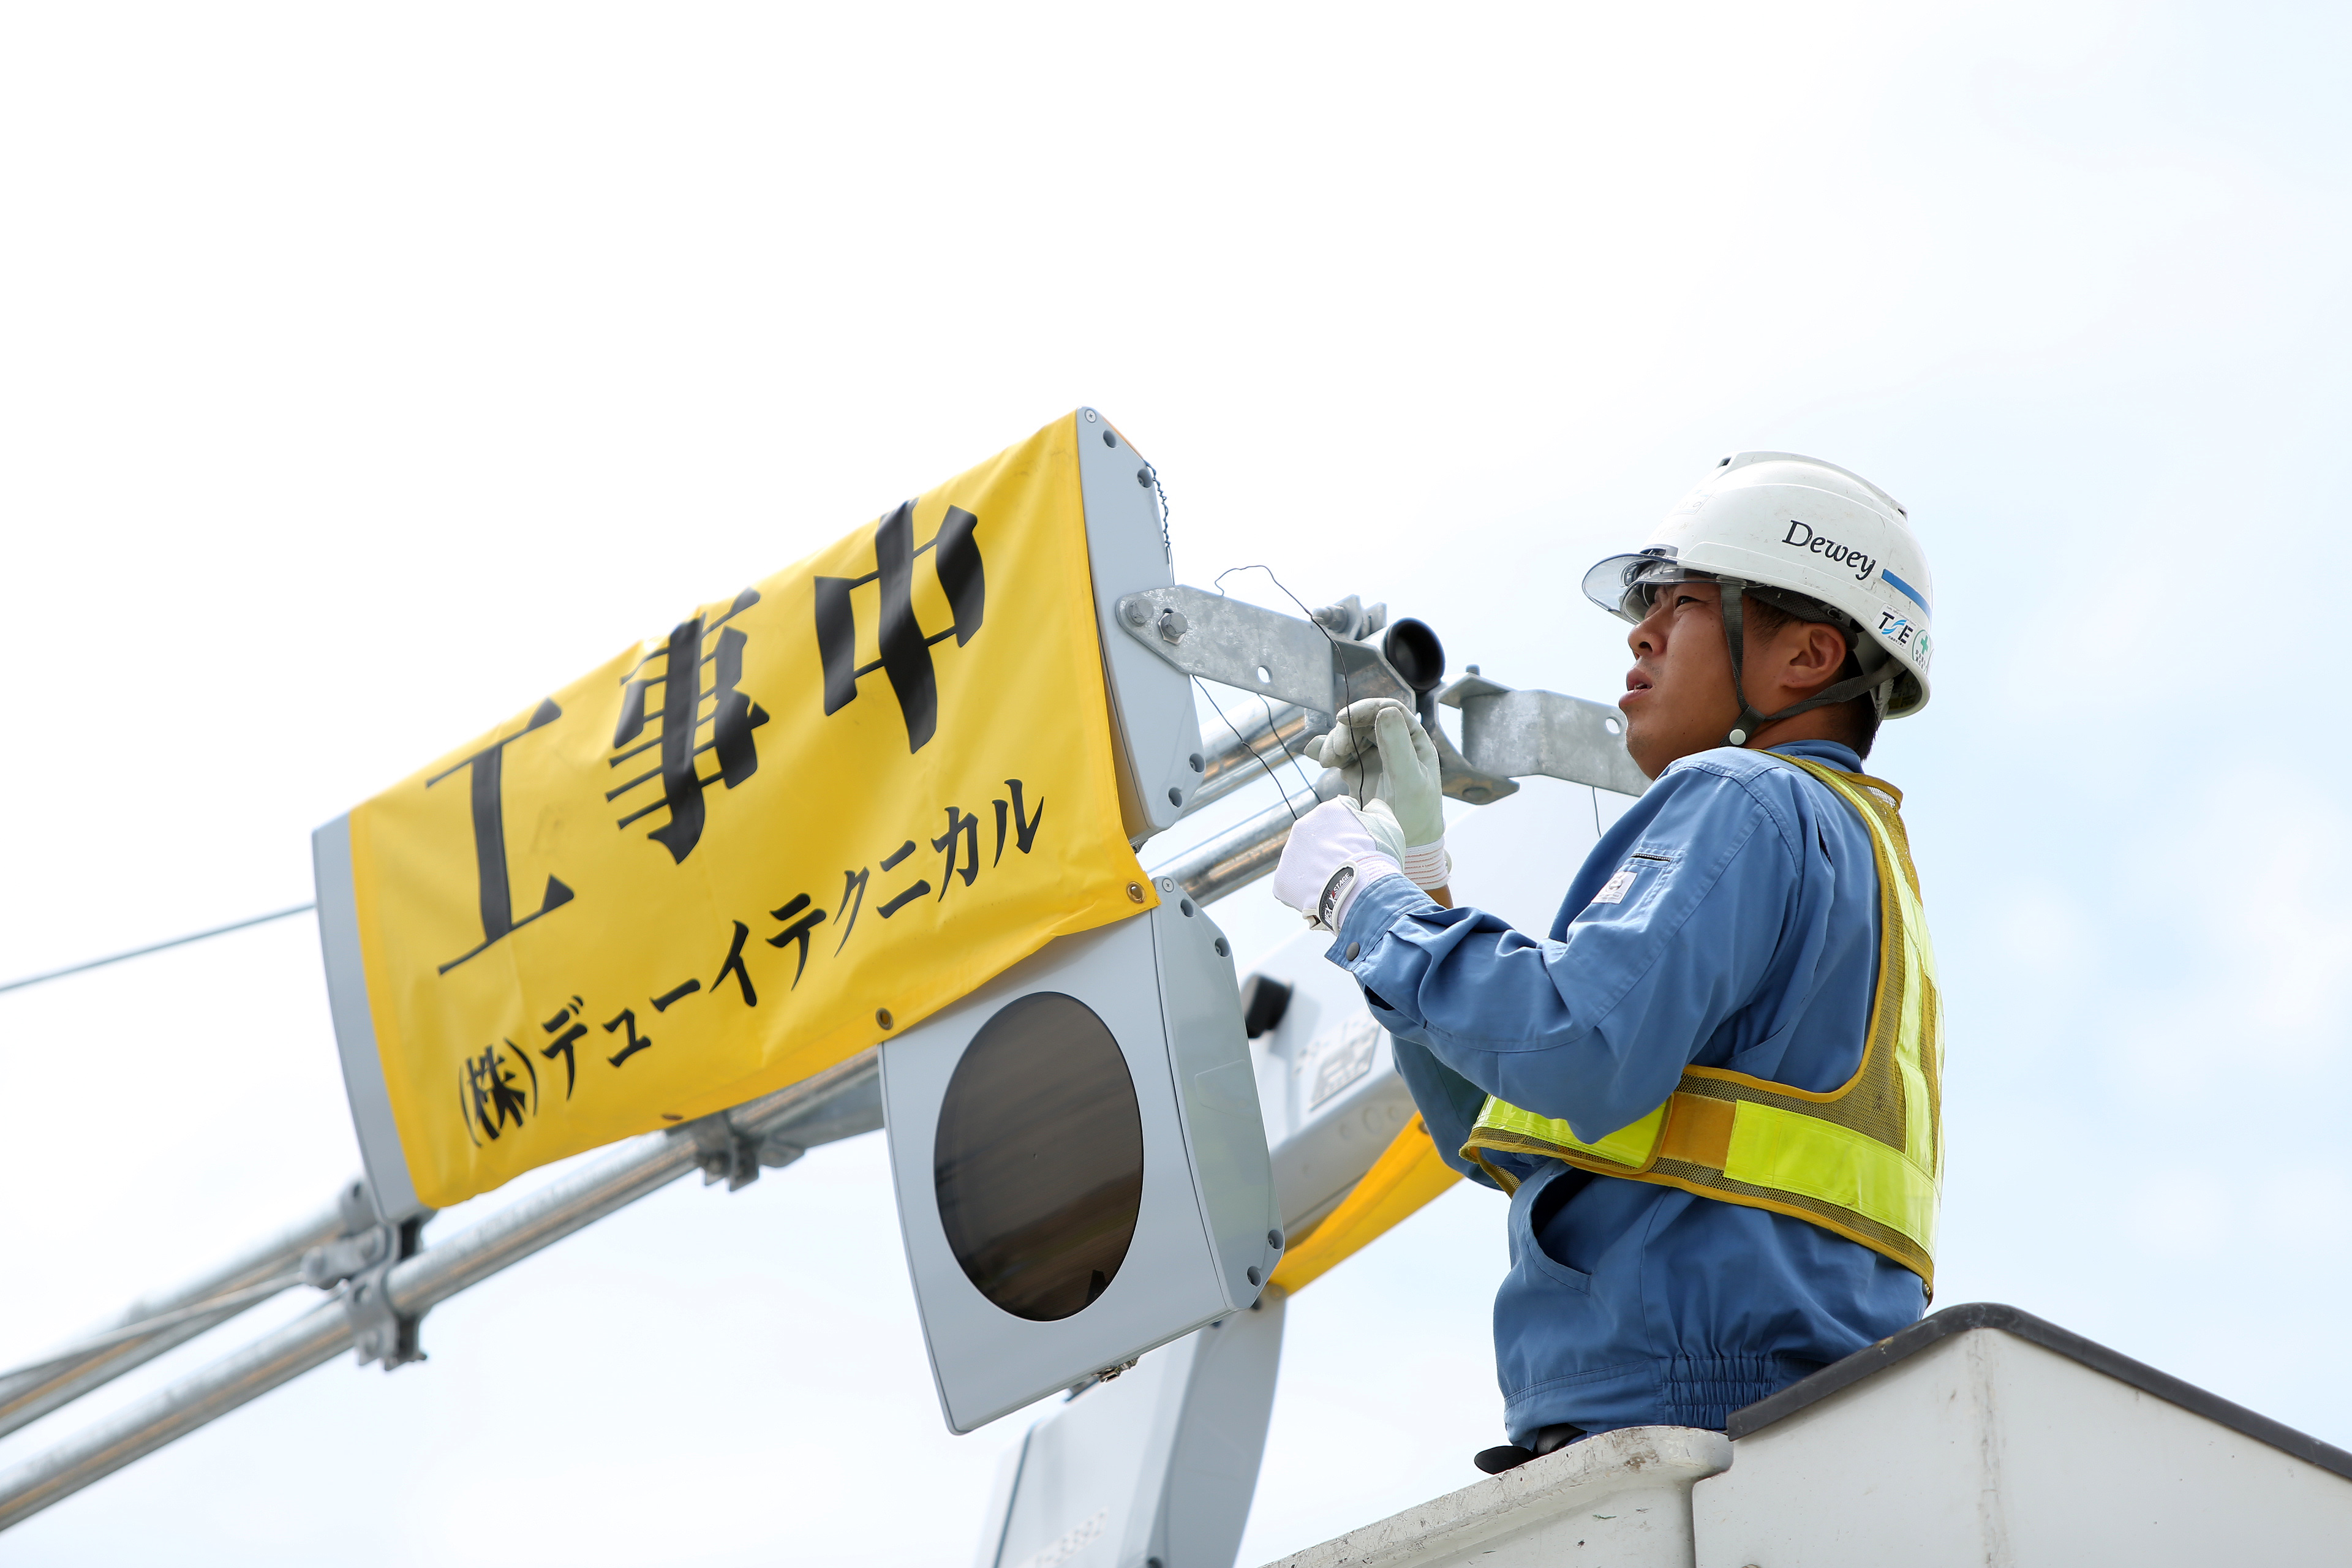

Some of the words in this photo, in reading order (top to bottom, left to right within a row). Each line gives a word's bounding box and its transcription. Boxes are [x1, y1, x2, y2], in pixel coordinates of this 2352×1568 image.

[1782, 520, 1876, 580] Dewey
[426, 497, 985, 976] 工事中
